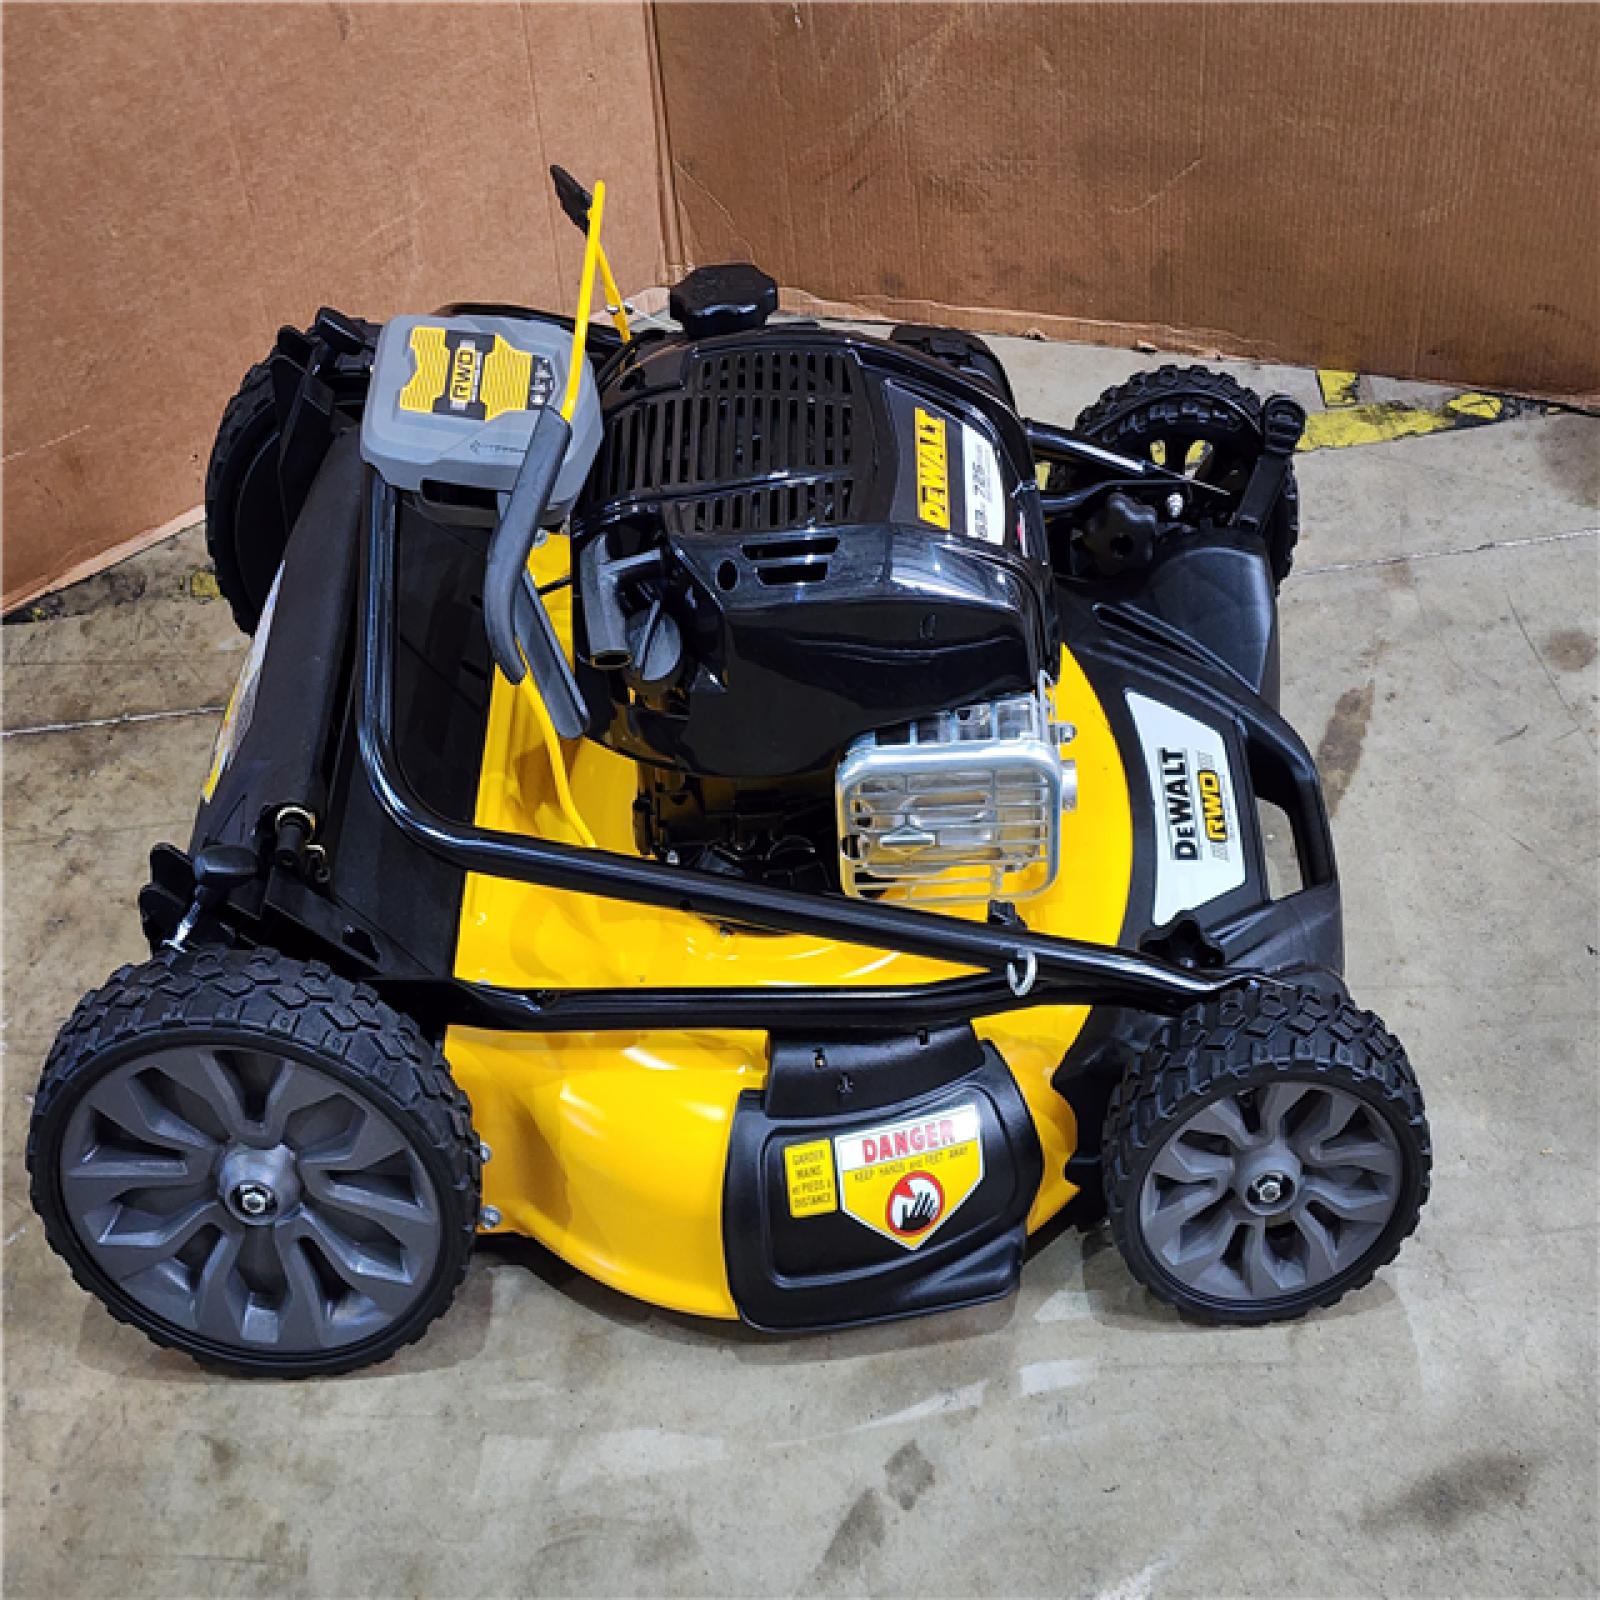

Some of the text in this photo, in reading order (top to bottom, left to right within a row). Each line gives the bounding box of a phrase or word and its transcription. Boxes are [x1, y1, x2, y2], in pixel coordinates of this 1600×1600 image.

[451, 349, 475, 400] RWD
[1161, 747, 1198, 860] DEWALT
[1198, 770, 1228, 841] RWD
[854, 1169, 875, 1182] KEEP
[879, 1162, 905, 1175] HANDS
[925, 1152, 943, 1164] FEET
[862, 1120, 954, 1163] DANGER
